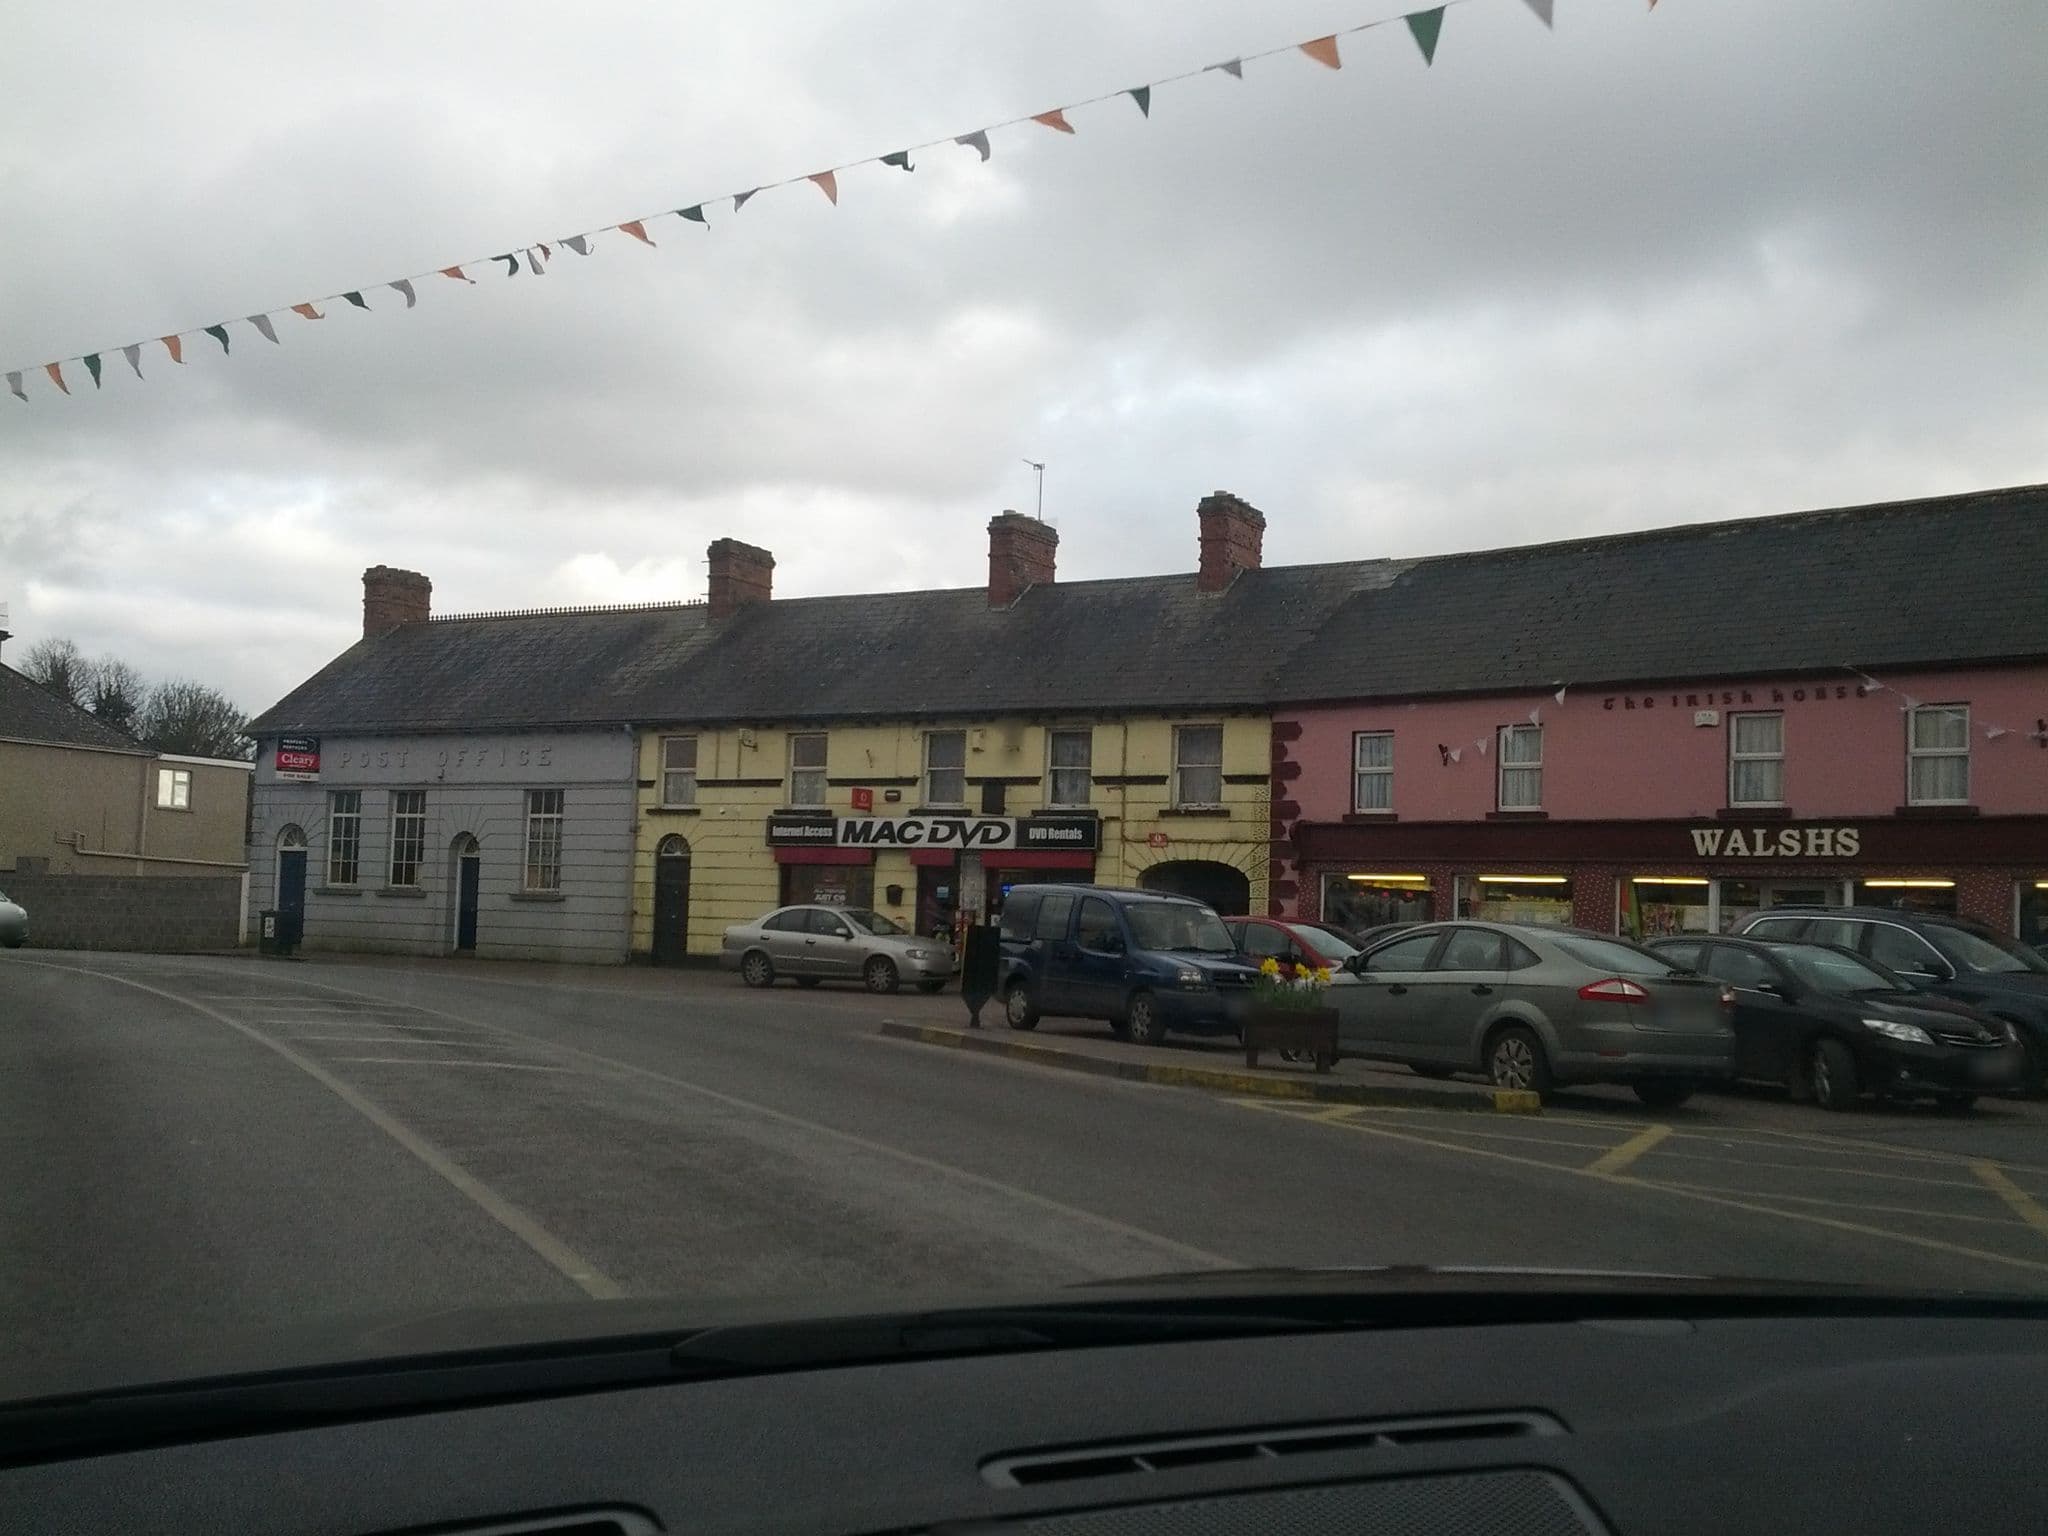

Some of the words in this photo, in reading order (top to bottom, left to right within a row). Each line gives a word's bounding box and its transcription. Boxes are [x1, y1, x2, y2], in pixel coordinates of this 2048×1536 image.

[281, 753, 315, 767] Cleary
[339, 750, 409, 769] POST
[438, 747, 551, 768] OFFICE
[772, 826, 804, 837] Internet
[804, 826, 833, 837] Access
[1029, 827, 1047, 840] DVD
[1047, 827, 1083, 840] Rentals
[1691, 828, 1860, 856] WALSHS
